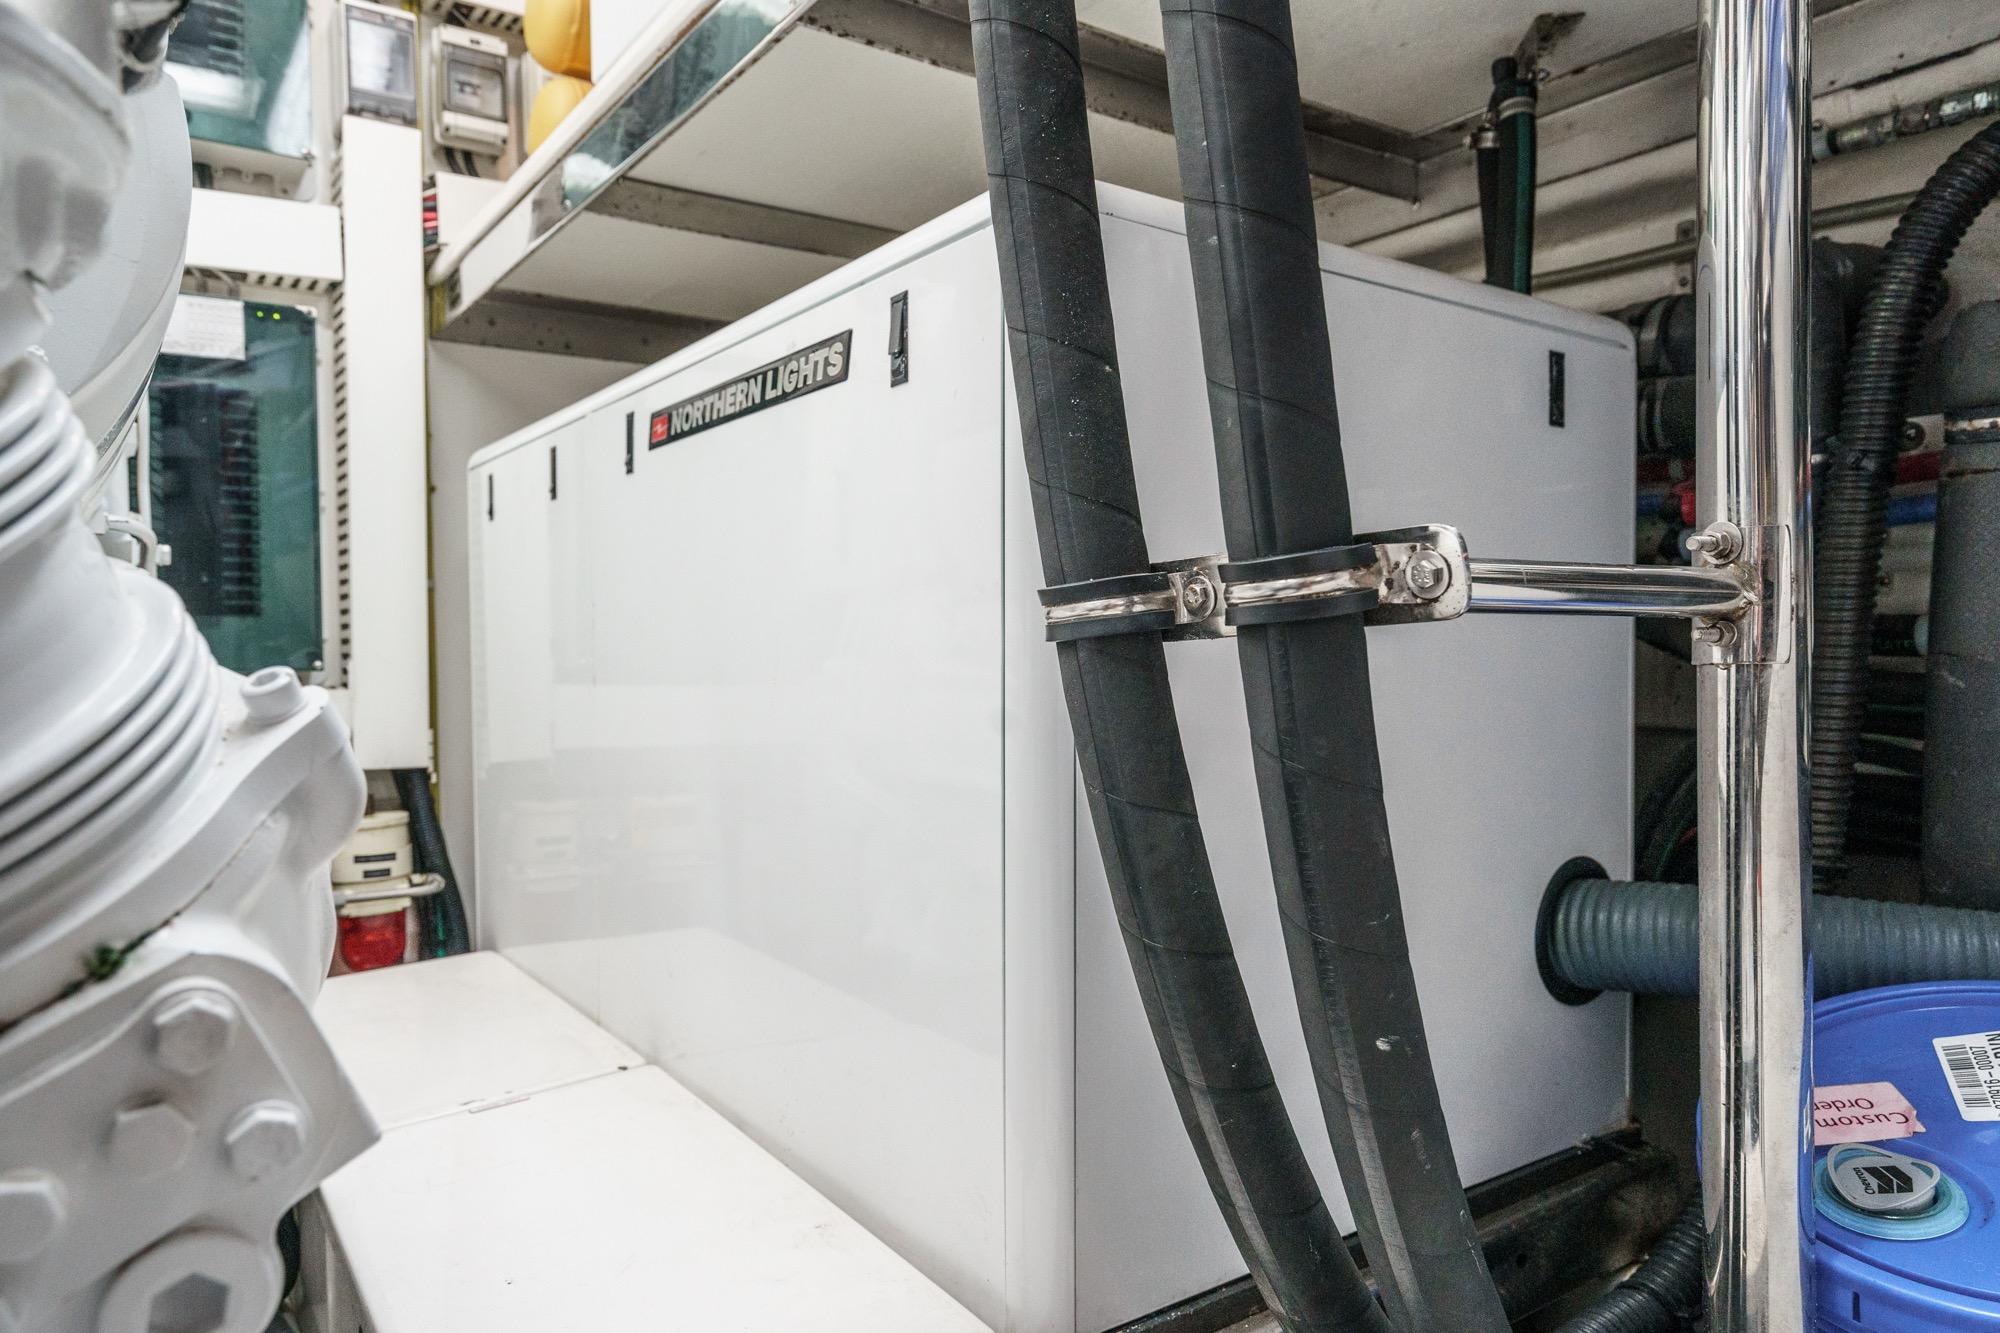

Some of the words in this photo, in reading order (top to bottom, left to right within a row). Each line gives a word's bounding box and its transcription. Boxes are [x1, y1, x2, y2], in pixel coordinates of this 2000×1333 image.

[670, 375, 764, 436] NORTHERN
[765, 342, 844, 400] LIGHTS
[1814, 1098, 1874, 1112] Order
[1815, 1112, 1910, 1128] Custom
[1853, 1167, 1876, 1195] Chevron
